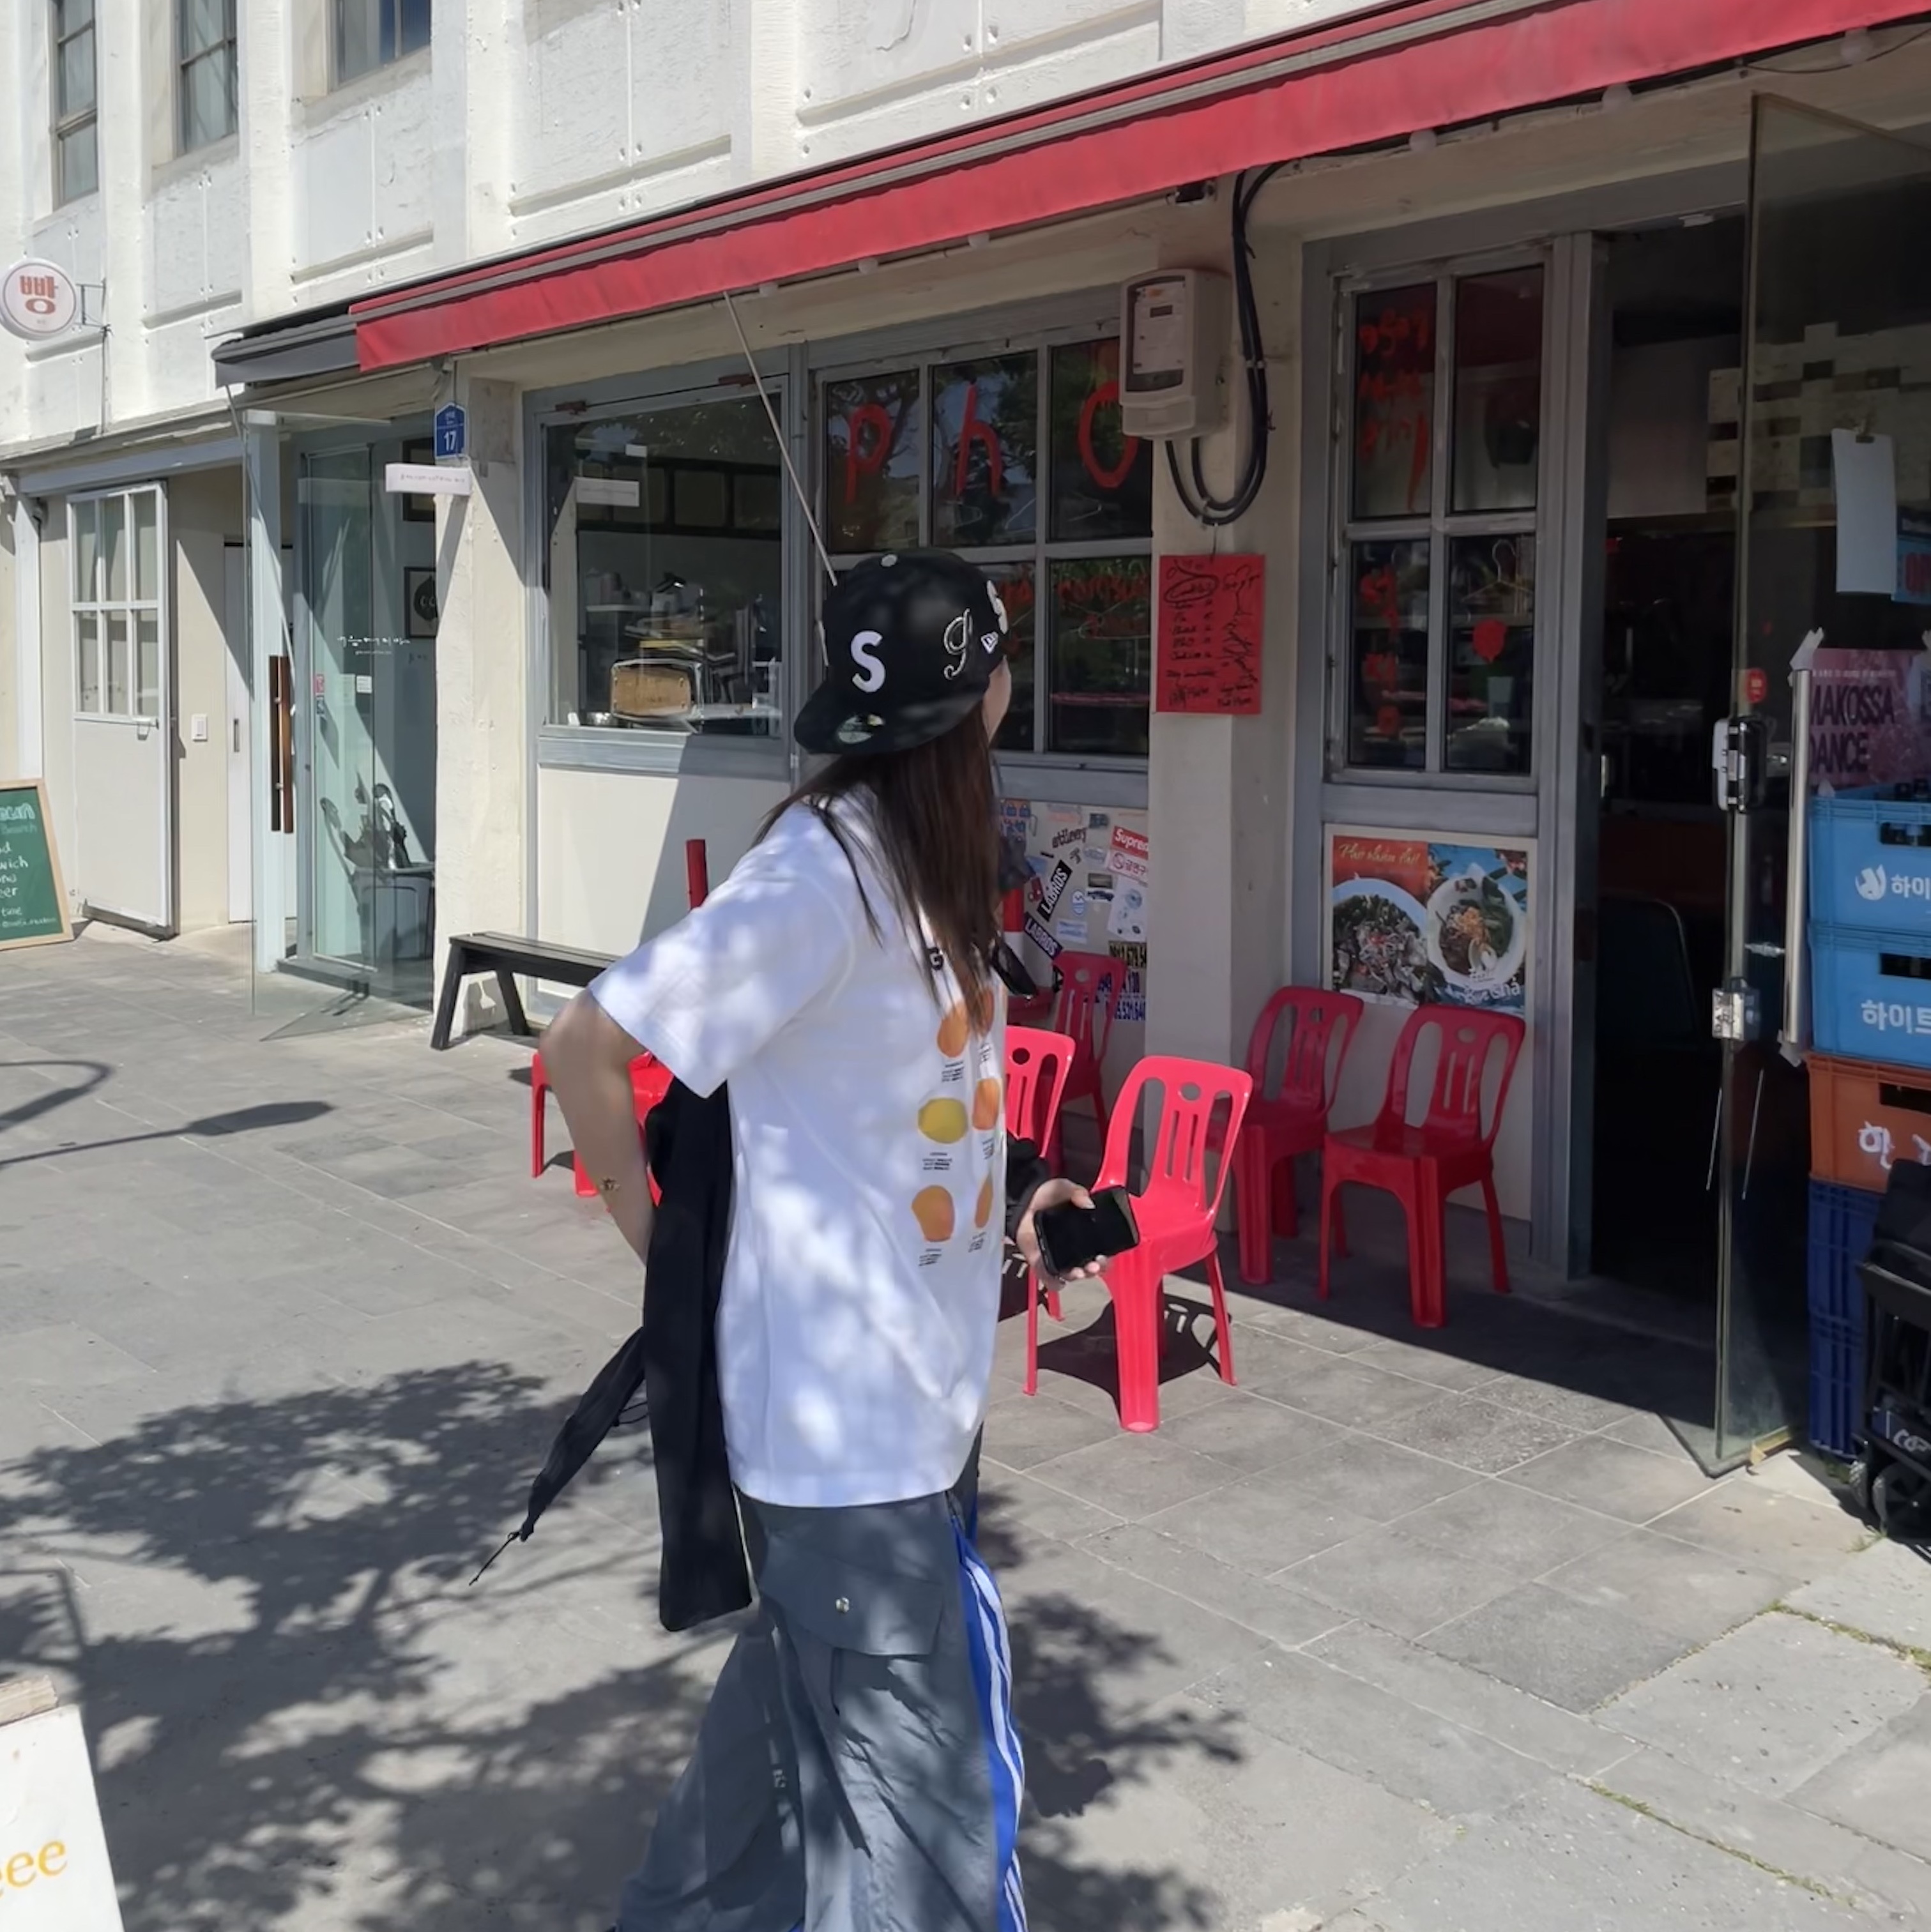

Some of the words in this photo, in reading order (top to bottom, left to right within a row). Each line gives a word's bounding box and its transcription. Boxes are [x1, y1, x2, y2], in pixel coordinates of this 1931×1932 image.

[19, 275, 59, 315] 빵
[443, 430, 457, 452] 17
[851, 630, 886, 693] S
[1115, 828, 1148, 851] Supre
[0, 1840, 68, 1898] ee
